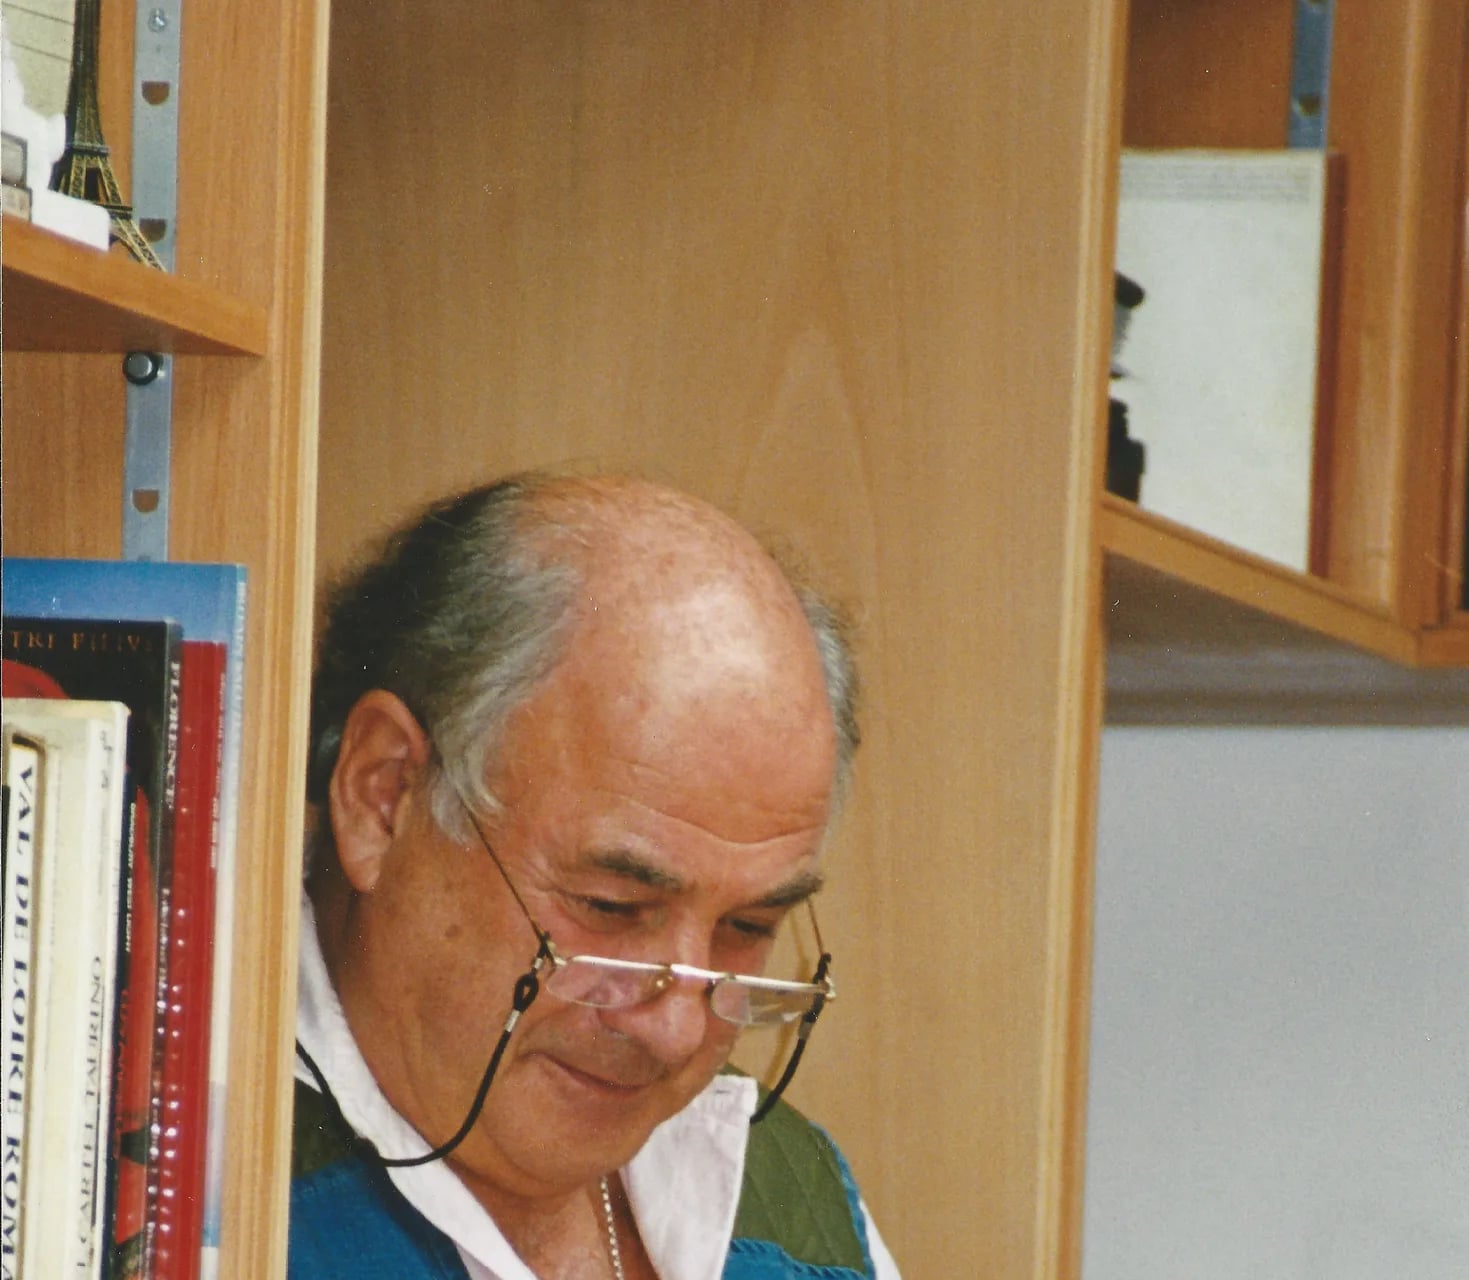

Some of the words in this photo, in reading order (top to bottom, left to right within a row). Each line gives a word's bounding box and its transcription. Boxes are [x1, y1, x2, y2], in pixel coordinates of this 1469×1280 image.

[168, 661, 181, 810] FLORENCE
[15, 765, 34, 855] VAL
[12, 873, 30, 940] DE
[7, 958, 28, 1114] LOIRE
[85, 955, 101, 1099] TAURINO
